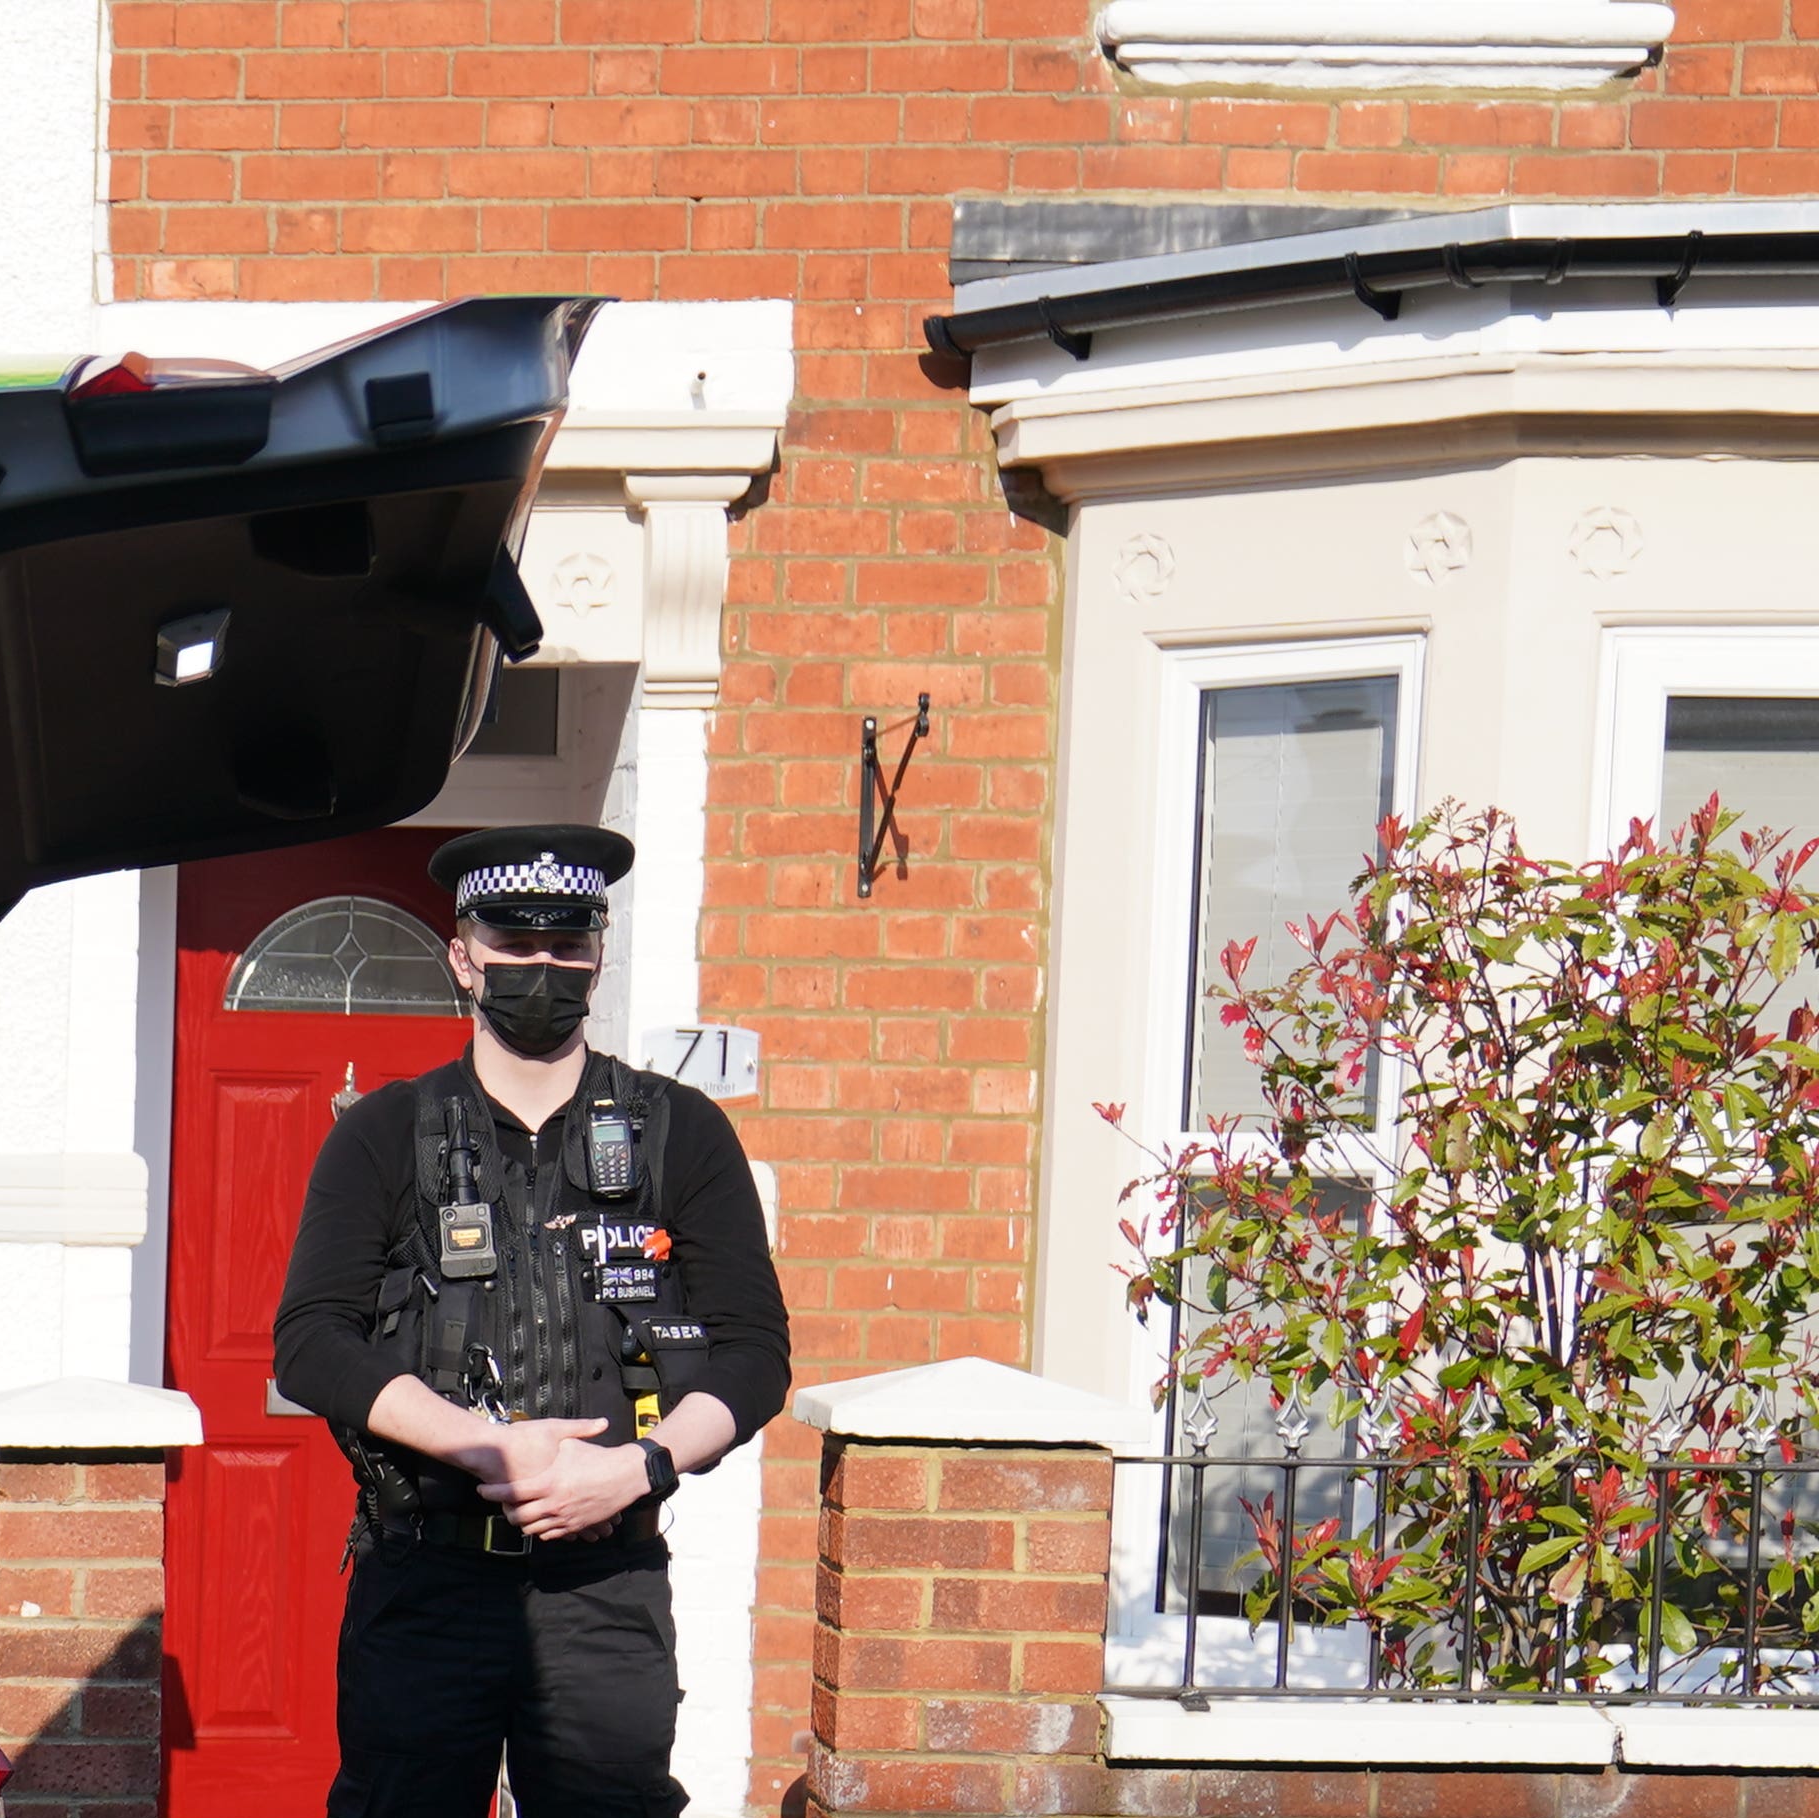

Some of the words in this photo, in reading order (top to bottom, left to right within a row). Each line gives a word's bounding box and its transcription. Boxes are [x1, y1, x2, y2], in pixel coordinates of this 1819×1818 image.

[675, 1029, 729, 1077] 71
[602, 1286, 616, 1299] PC
[651, 1325, 703, 1339] TASER
